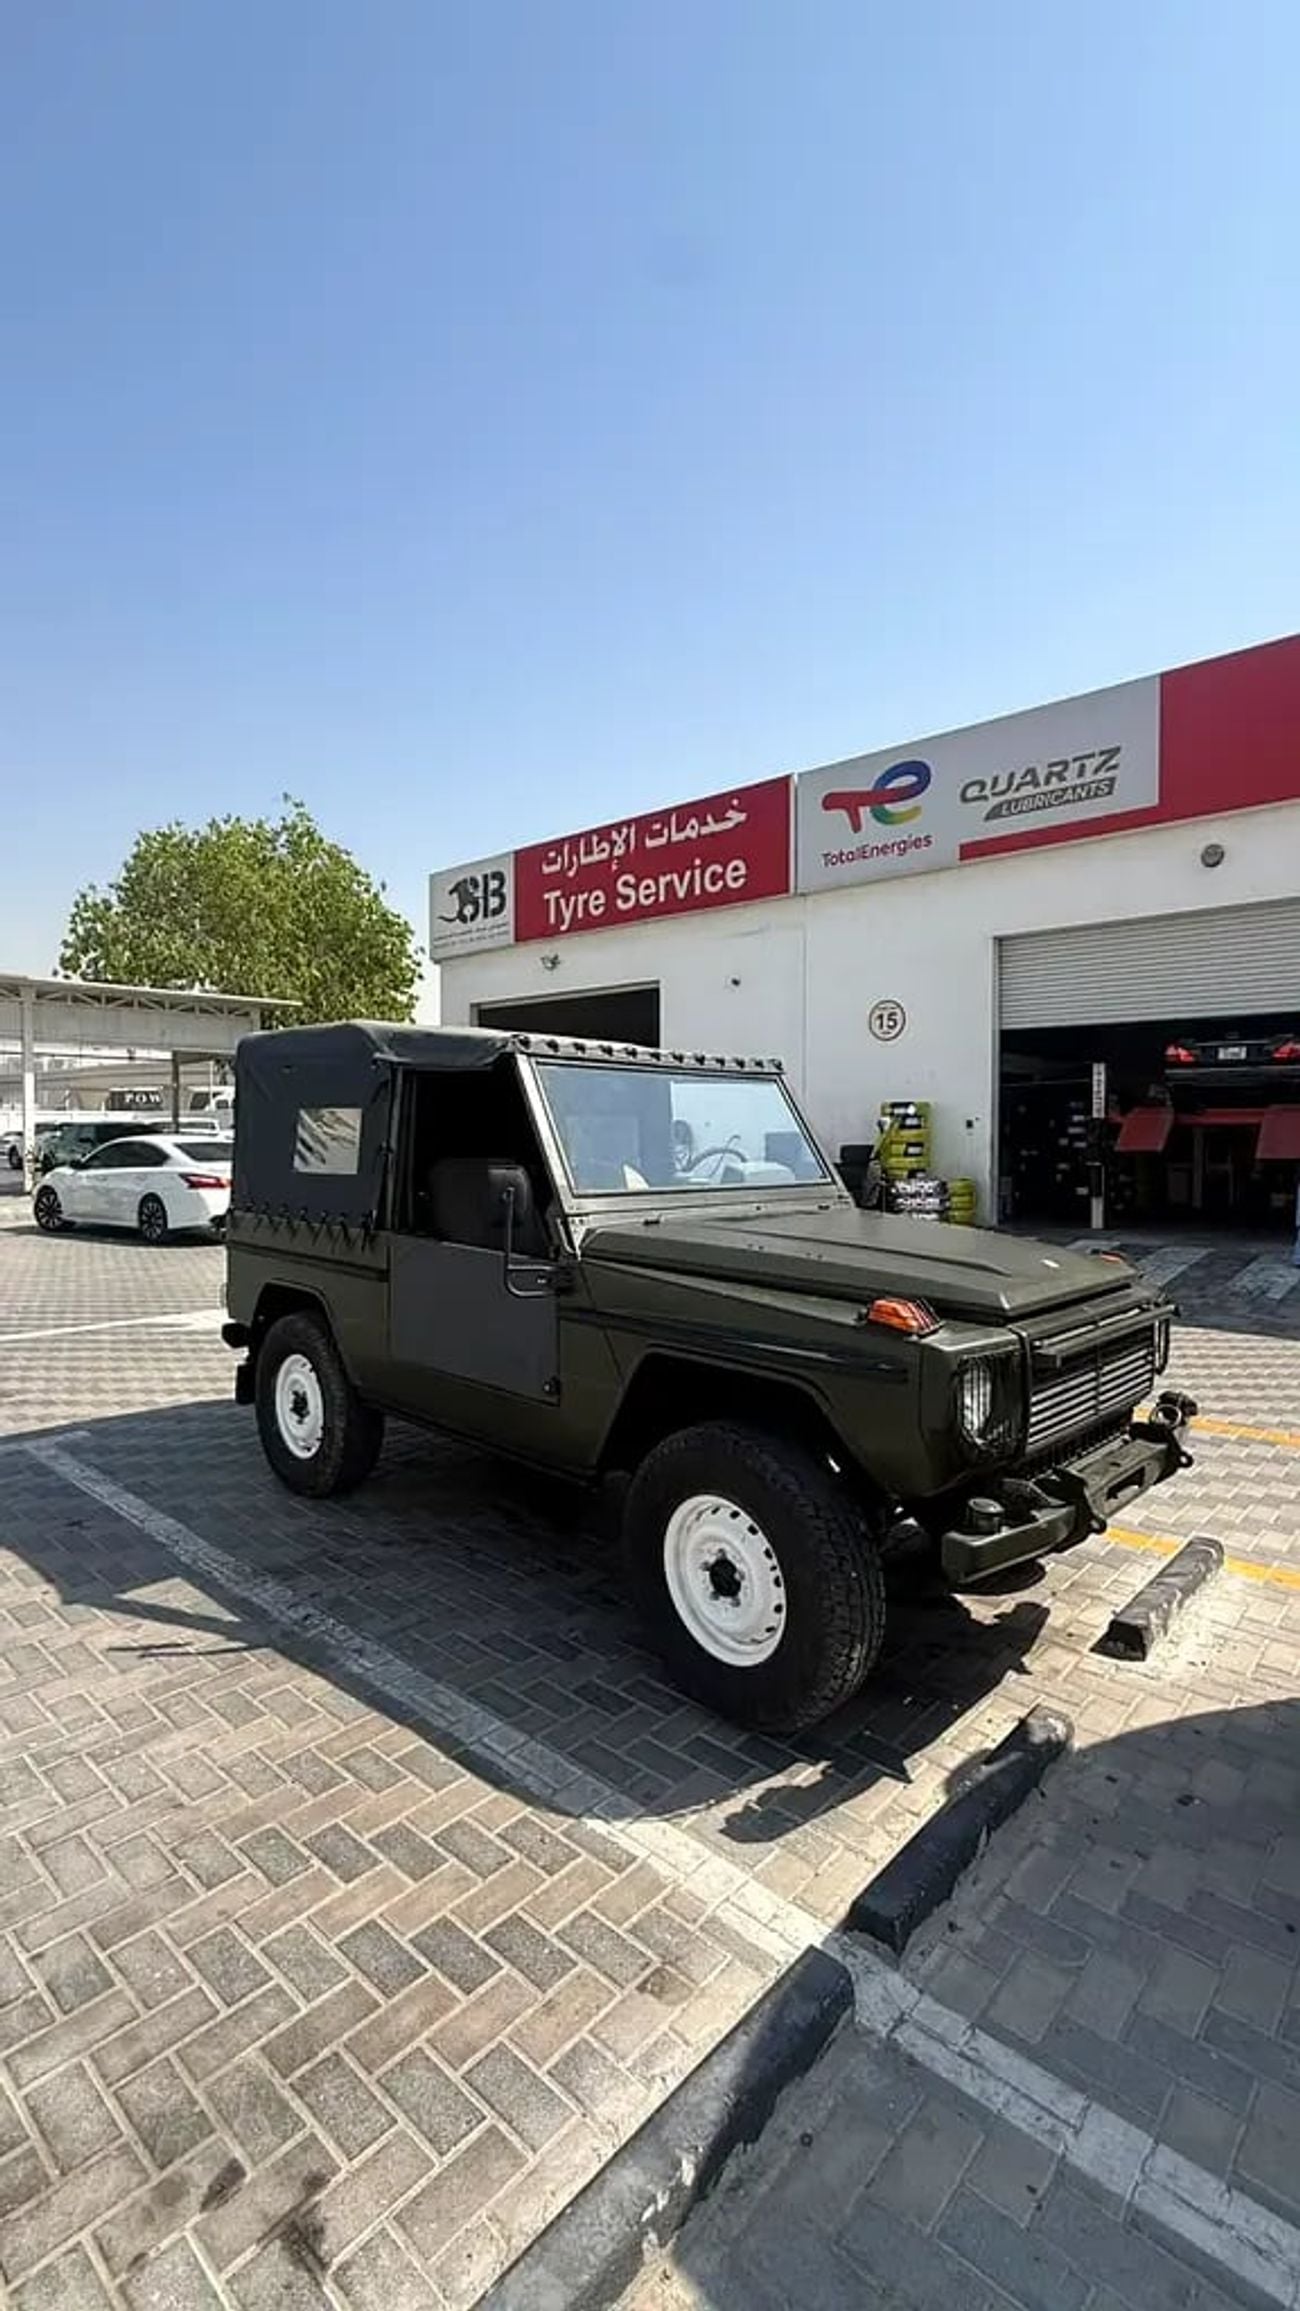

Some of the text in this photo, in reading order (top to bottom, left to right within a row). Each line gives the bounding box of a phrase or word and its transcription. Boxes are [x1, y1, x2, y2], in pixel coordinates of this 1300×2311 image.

[960, 746, 1121, 804] QUARTZ
[998, 779, 1111, 817] LUBRICANTS
[541, 798, 748, 878] خدمات الإطارات
[821, 834, 933, 868] TotalEnergies
[543, 858, 747, 931] Tyre Service
[876, 1011, 898, 1030] 15
